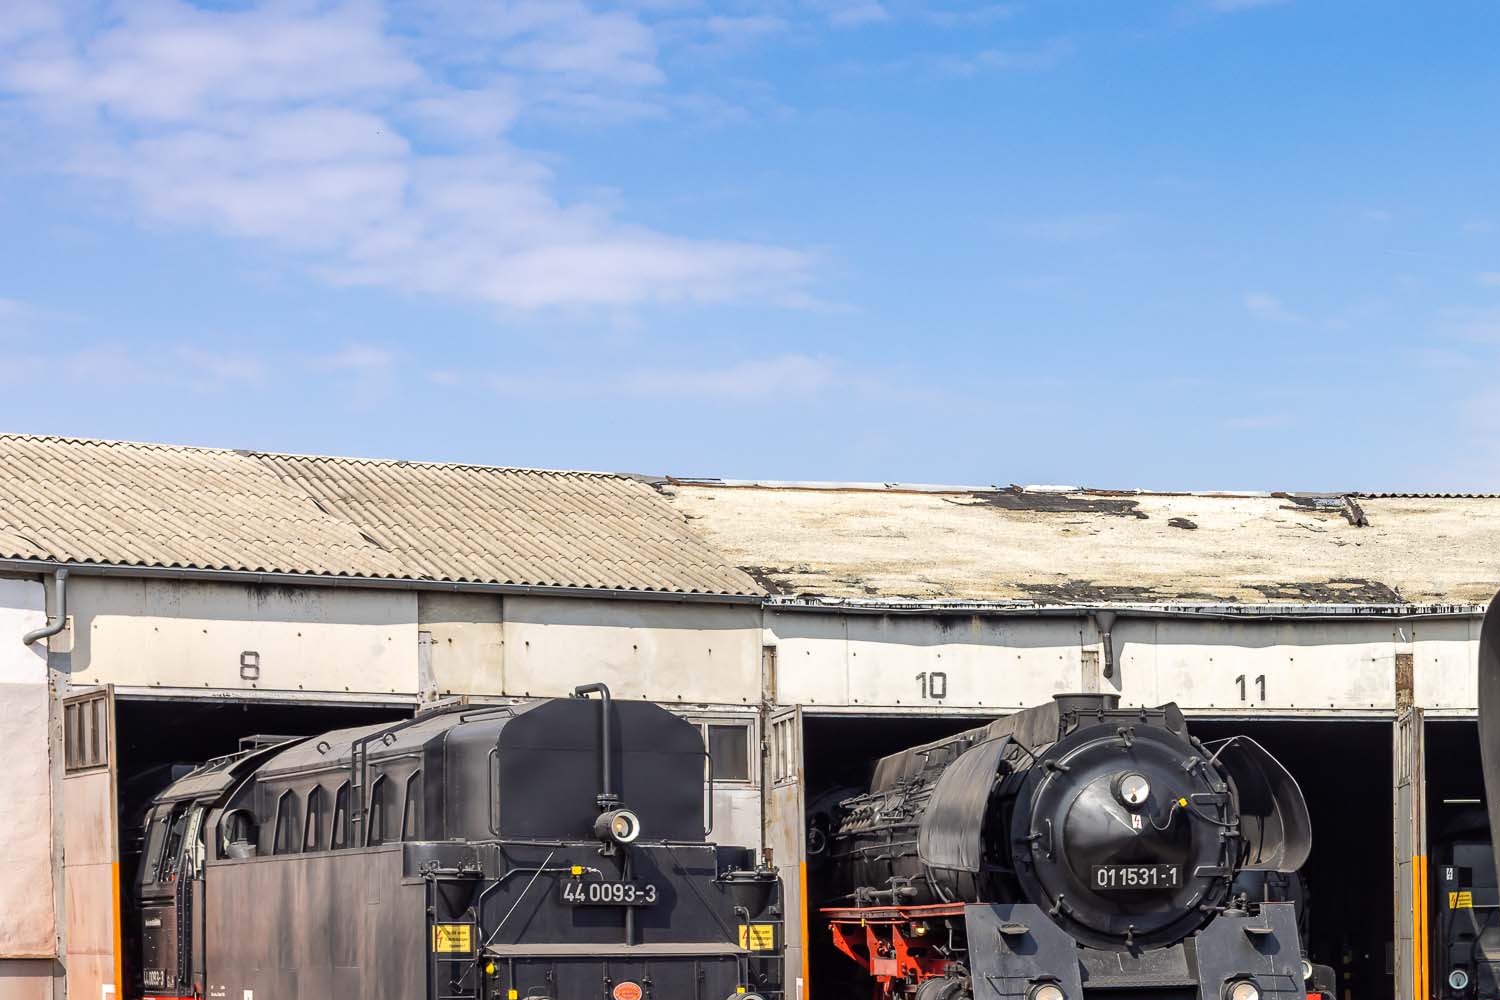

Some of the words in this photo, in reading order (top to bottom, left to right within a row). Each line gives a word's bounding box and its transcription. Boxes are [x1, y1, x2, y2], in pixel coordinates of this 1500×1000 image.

[240, 651, 260, 680] 8
[915, 672, 947, 699] 10
[1235, 674, 1265, 701] 11
